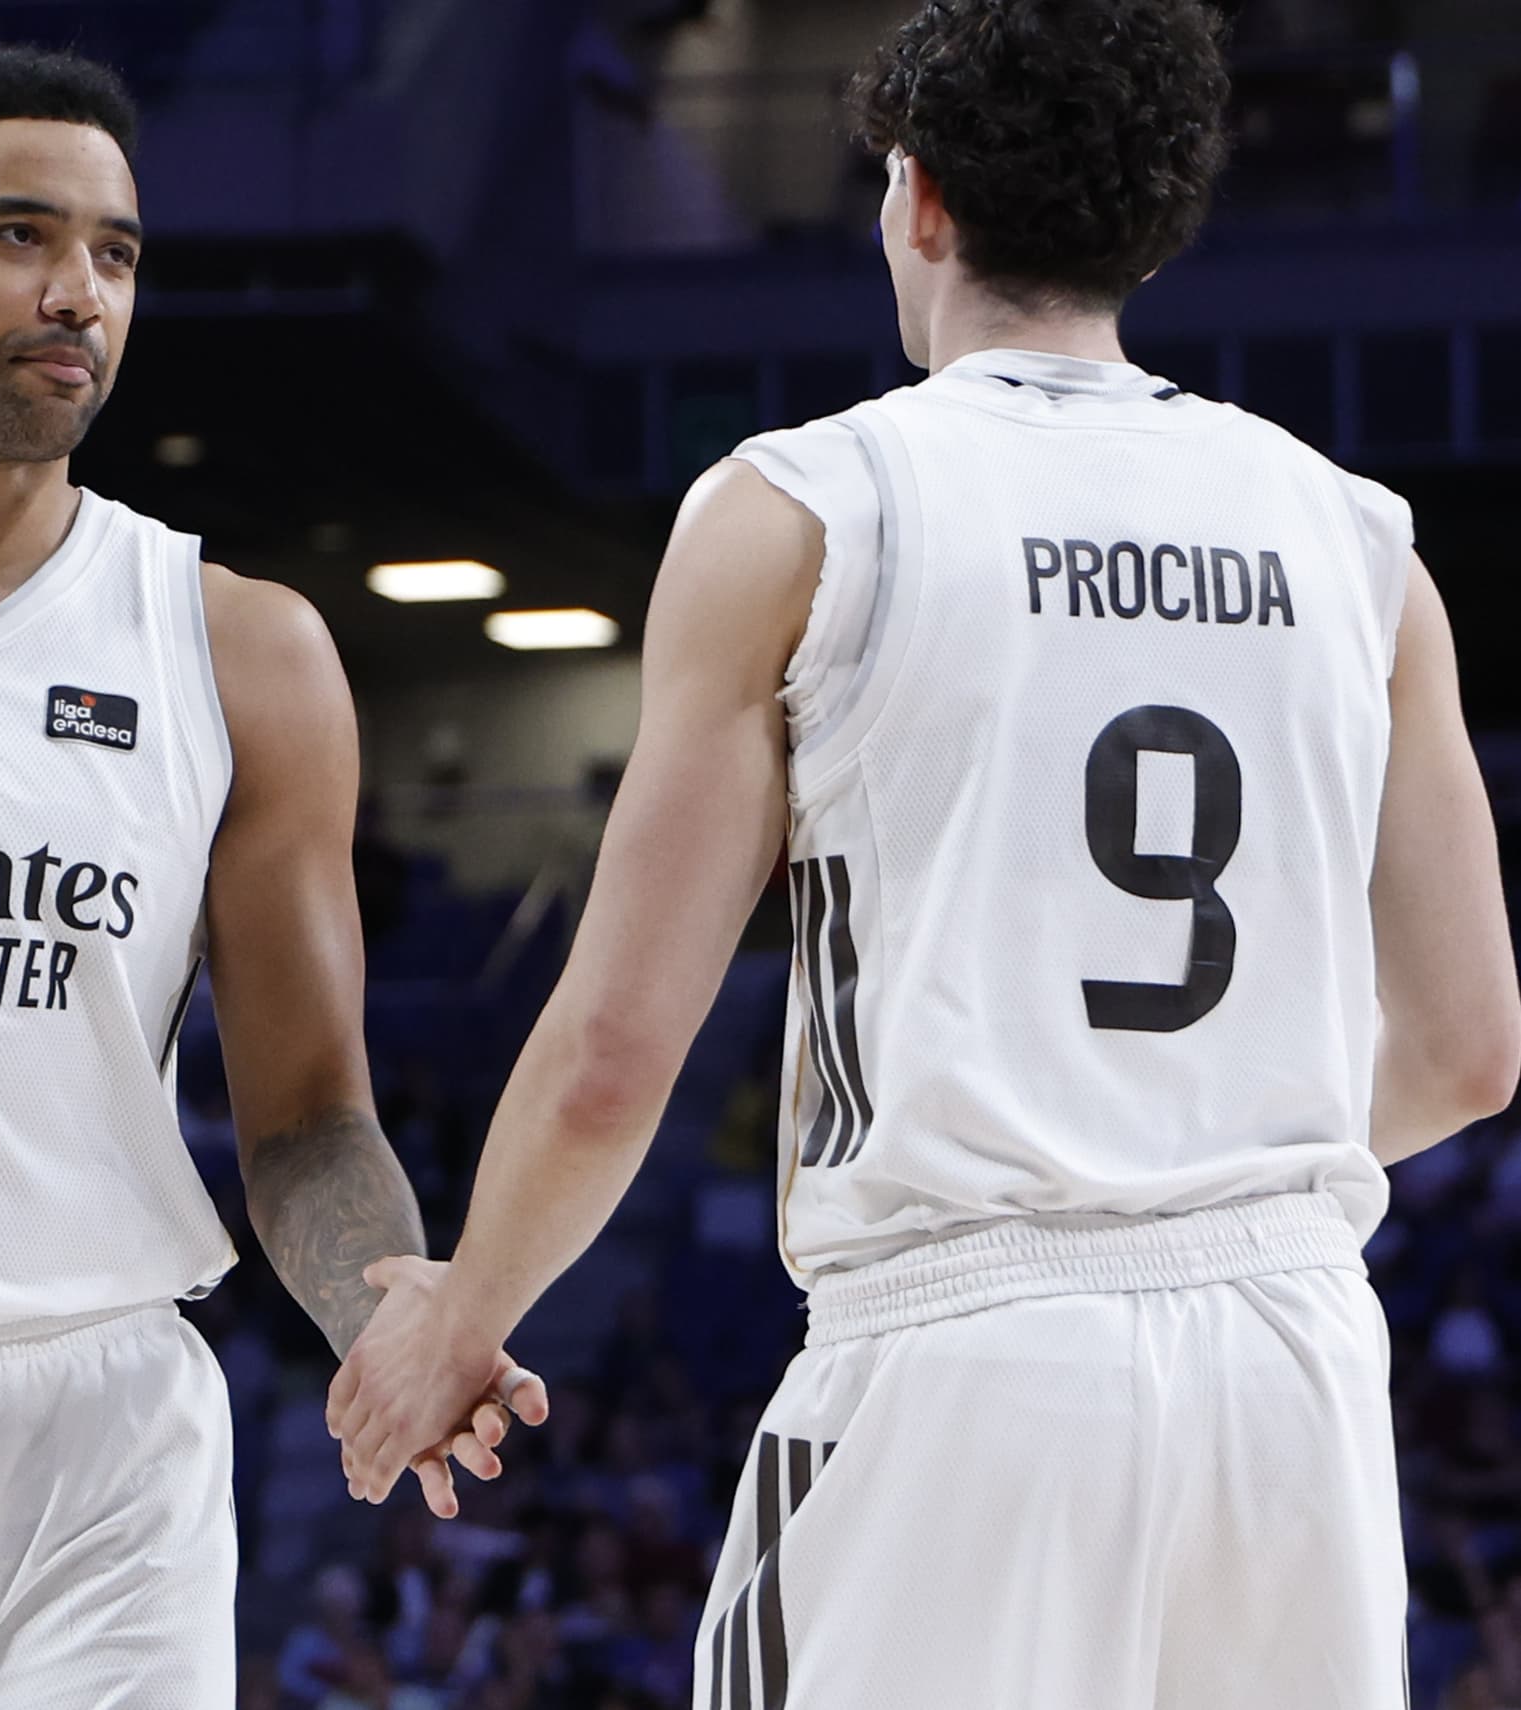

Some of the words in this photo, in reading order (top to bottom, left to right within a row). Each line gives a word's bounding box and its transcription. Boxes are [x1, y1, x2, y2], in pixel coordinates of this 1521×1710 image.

[1021, 537, 1296, 627] PROCIDA
[52, 718, 133, 745] endesa
[53, 698, 92, 719] liga
[1080, 704, 1243, 1033] 9
